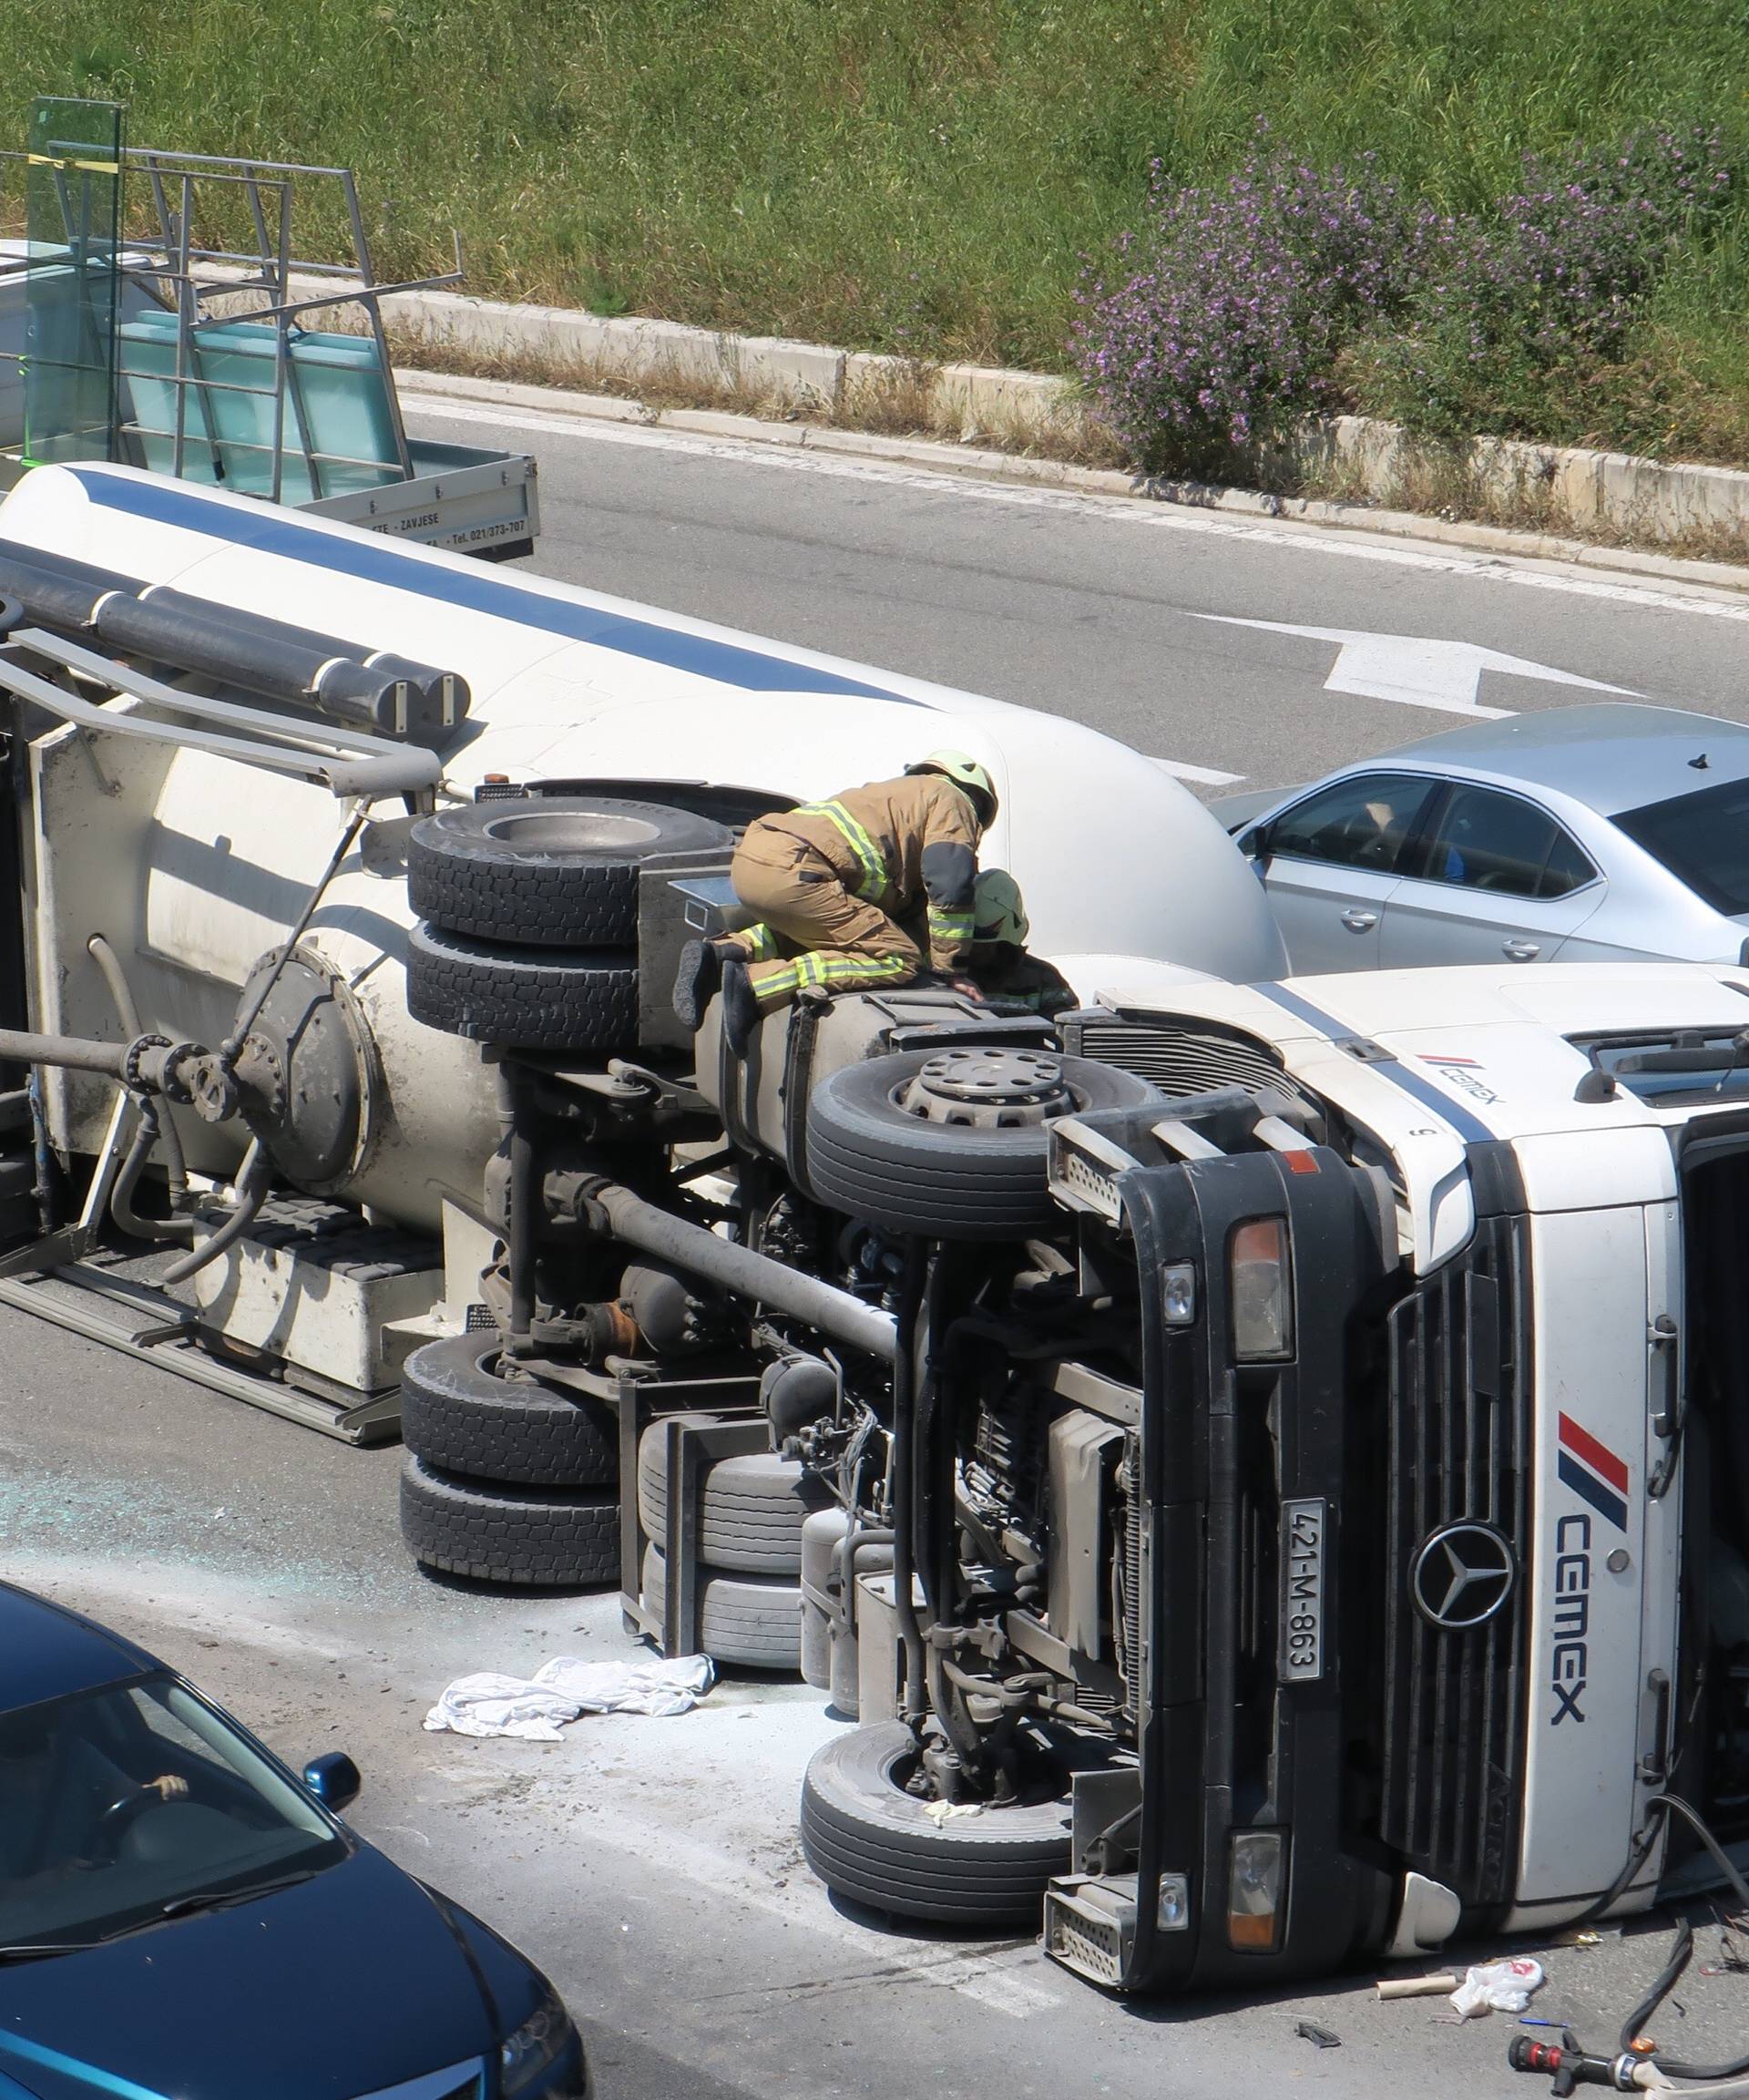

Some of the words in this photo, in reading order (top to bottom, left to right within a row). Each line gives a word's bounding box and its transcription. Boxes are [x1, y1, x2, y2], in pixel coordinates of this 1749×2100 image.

[400, 512, 439, 531] ZAVJESE
[452, 532, 469, 545] Tel.
[470, 519, 526, 541] 021/373-707
[1439, 1068, 1508, 1105] CEMEX
[1290, 1512, 1319, 1667] 421-M-863
[1550, 1512, 1591, 1726] CEMEX
